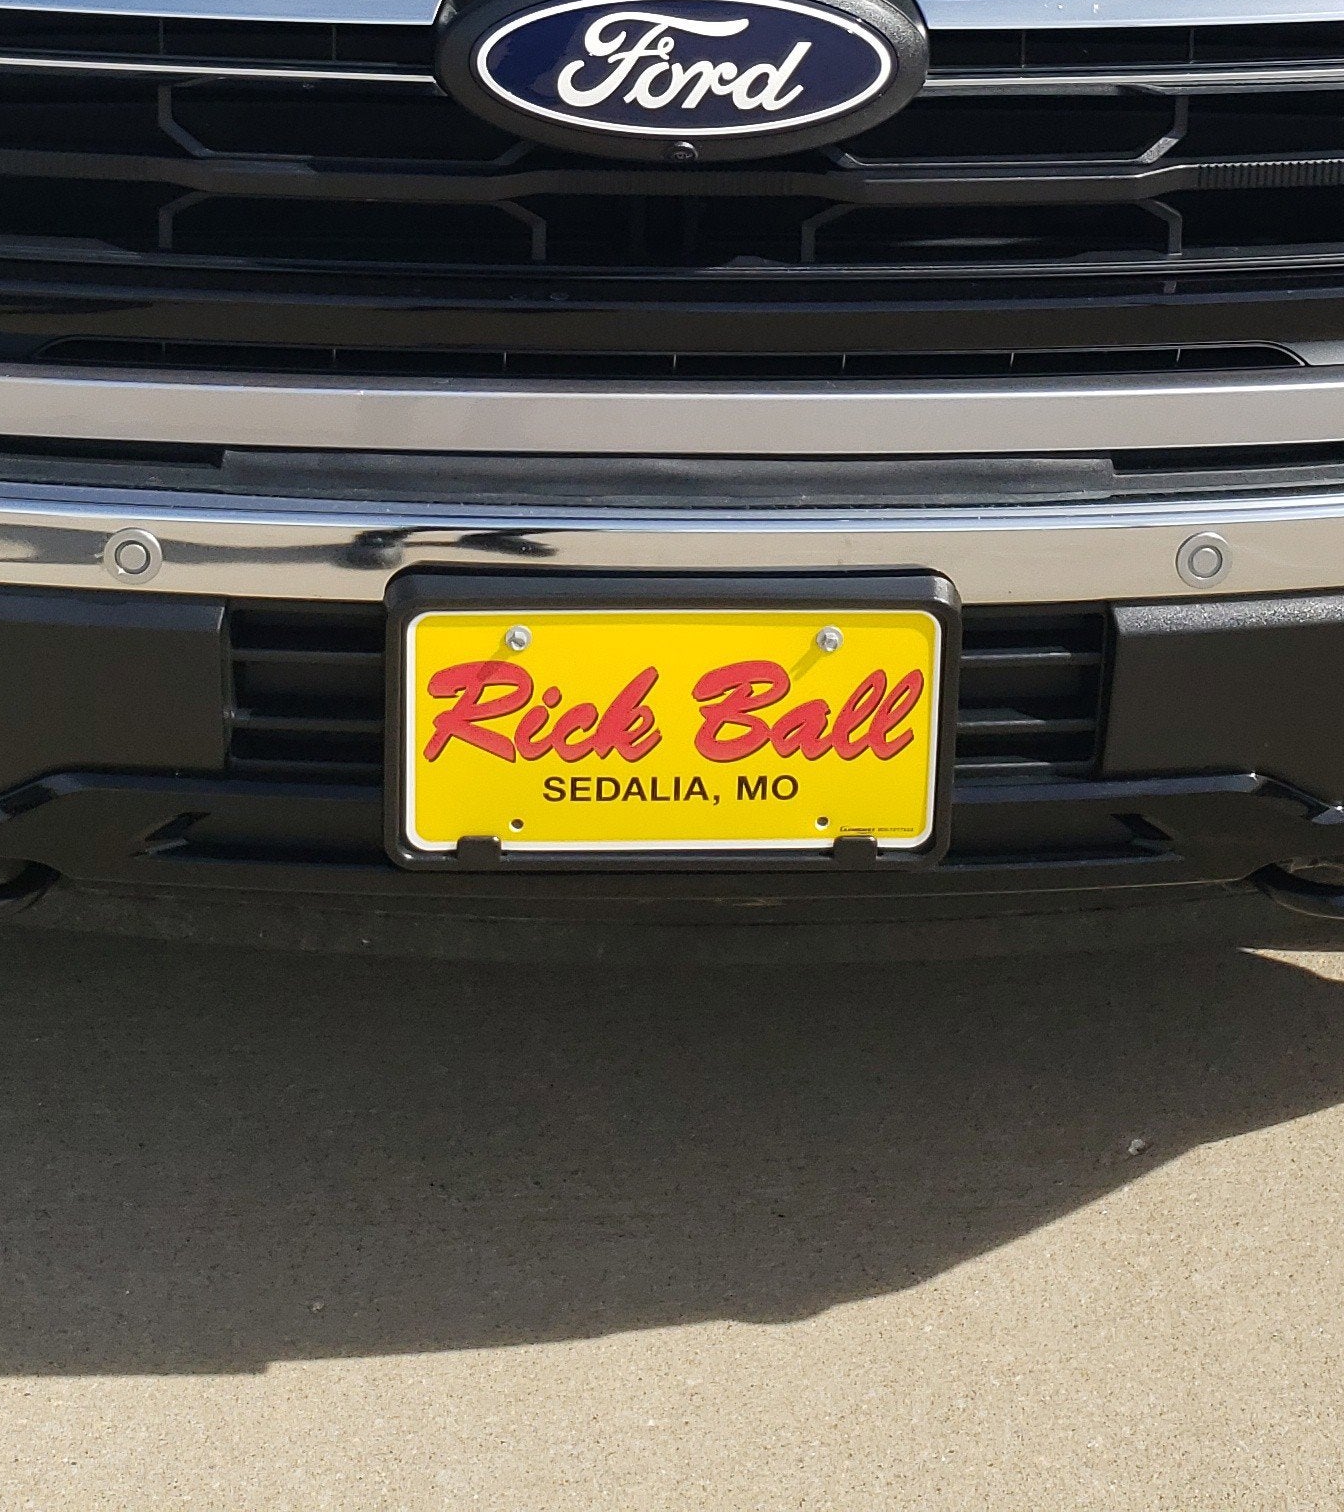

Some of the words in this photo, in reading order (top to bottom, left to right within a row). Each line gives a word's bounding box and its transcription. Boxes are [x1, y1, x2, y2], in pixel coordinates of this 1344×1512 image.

[557, 11, 812, 111] Ford
[423, 659, 662, 763] Rick
[692, 659, 925, 763] Ball
[542, 774, 721, 807] SEDALIA,
[736, 774, 799, 801] MO
